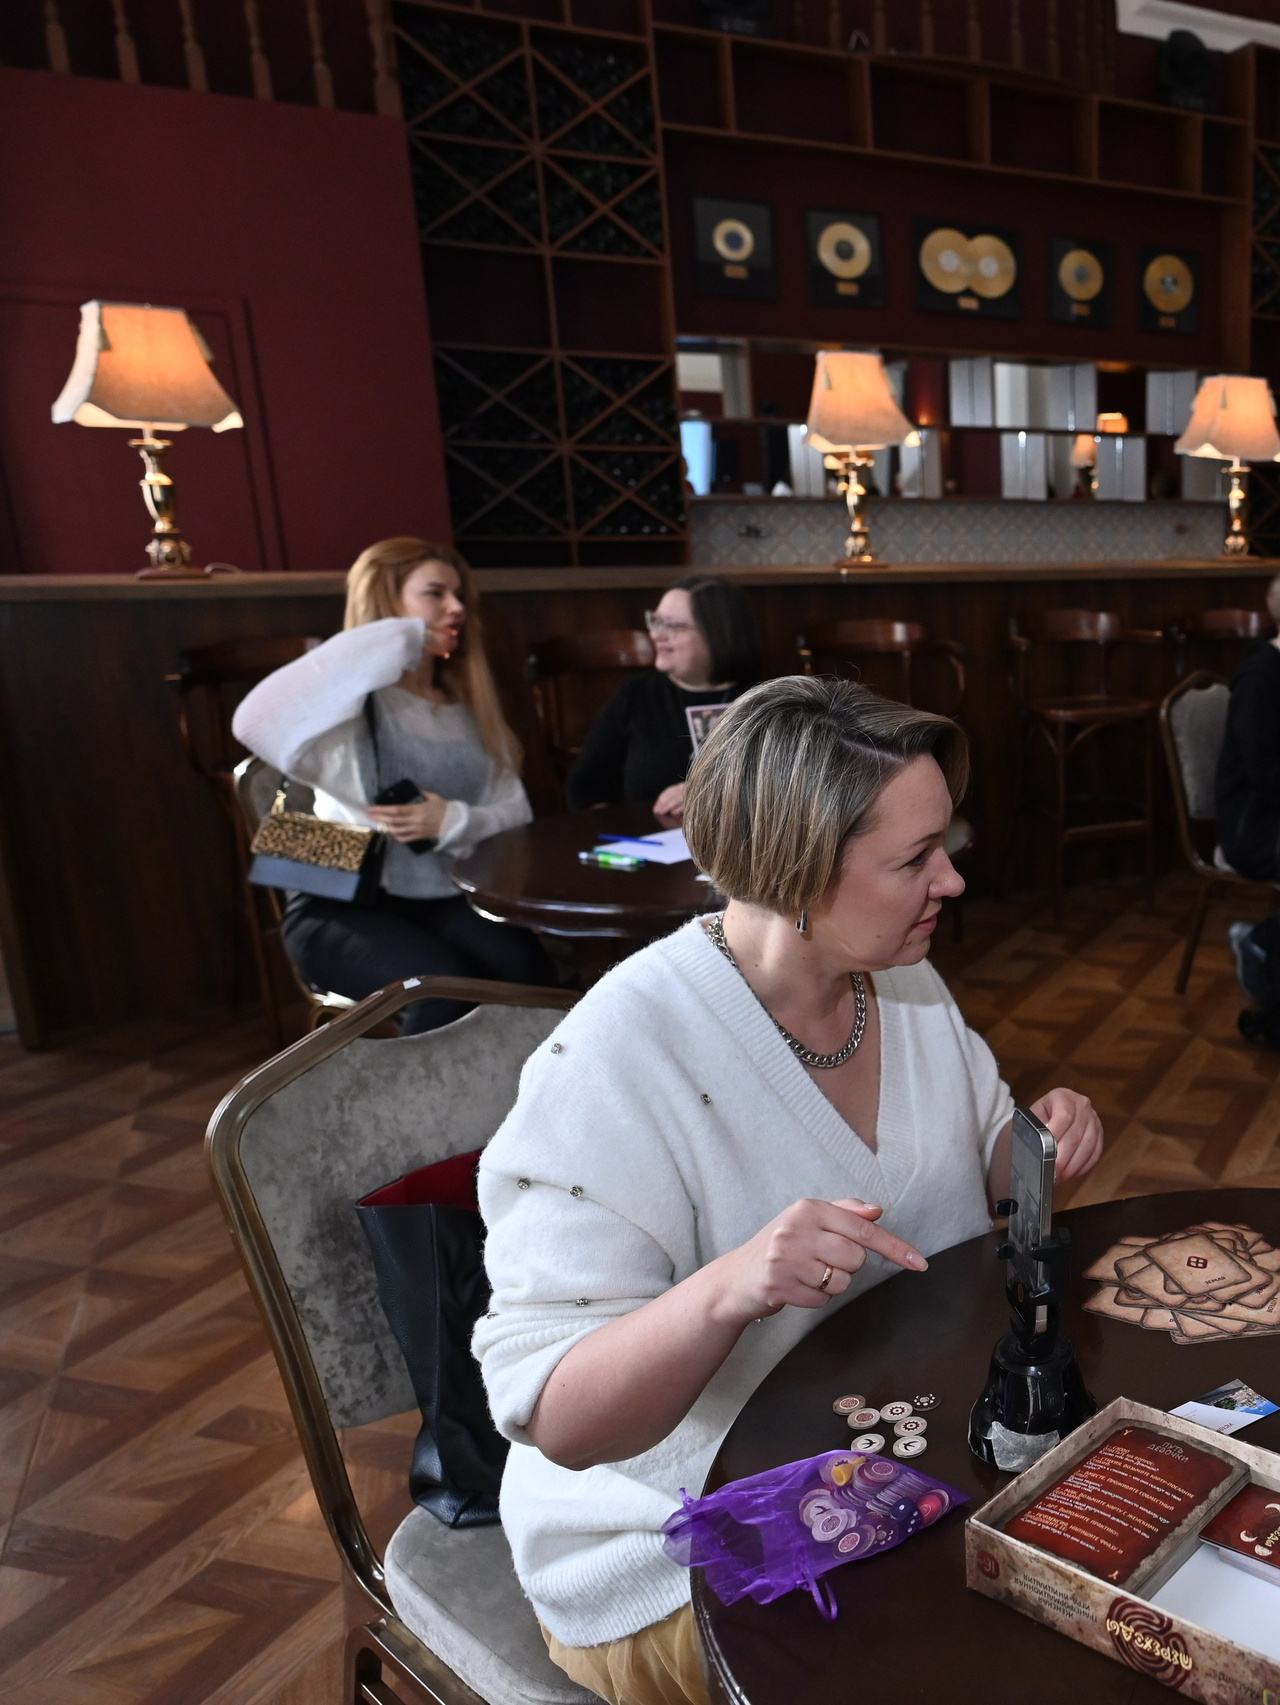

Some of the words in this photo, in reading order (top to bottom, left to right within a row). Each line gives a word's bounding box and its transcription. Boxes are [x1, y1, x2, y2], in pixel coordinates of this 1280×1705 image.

[1145, 1442, 1190, 1462] ДЕВОЧКИ
[1160, 1441, 1186, 1454] ПУТЬ
[1037, 1595, 1074, 1619] ЖЕНСКАЯ
[1106, 1618, 1193, 1671] ПЕРЕХОДЫ
